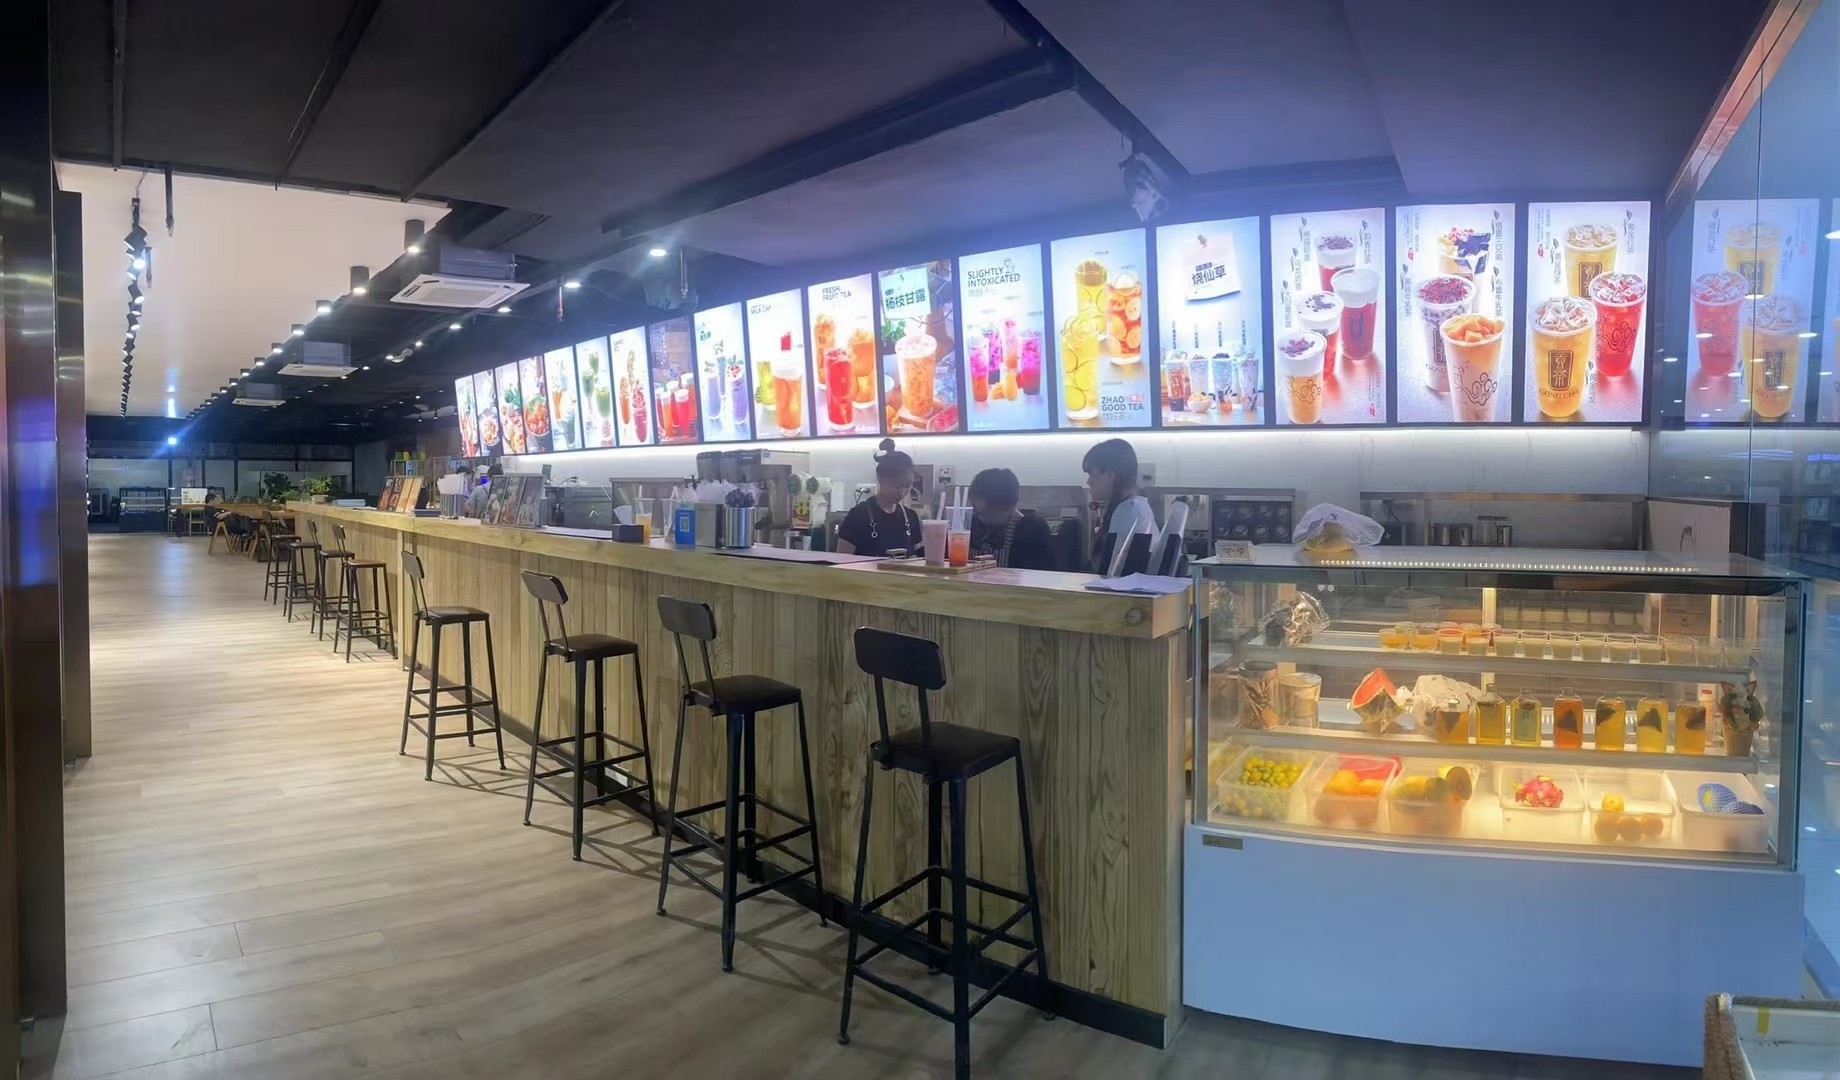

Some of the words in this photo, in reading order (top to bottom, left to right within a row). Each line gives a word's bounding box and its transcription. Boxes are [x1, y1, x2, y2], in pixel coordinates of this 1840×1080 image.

[967, 266, 1003, 280] SLIGHTLY
[1192, 264, 1226, 286] 烧仙草
[968, 273, 1020, 288] INTOXICATED
[822, 293, 839, 301] FRUIT
[840, 290, 852, 298] TEA
[885, 288, 926, 310] 杨枝甘露
[1101, 395, 1125, 404] ZHAO
[1101, 403, 1127, 412] GOOD
[1128, 403, 1144, 411] TEA
